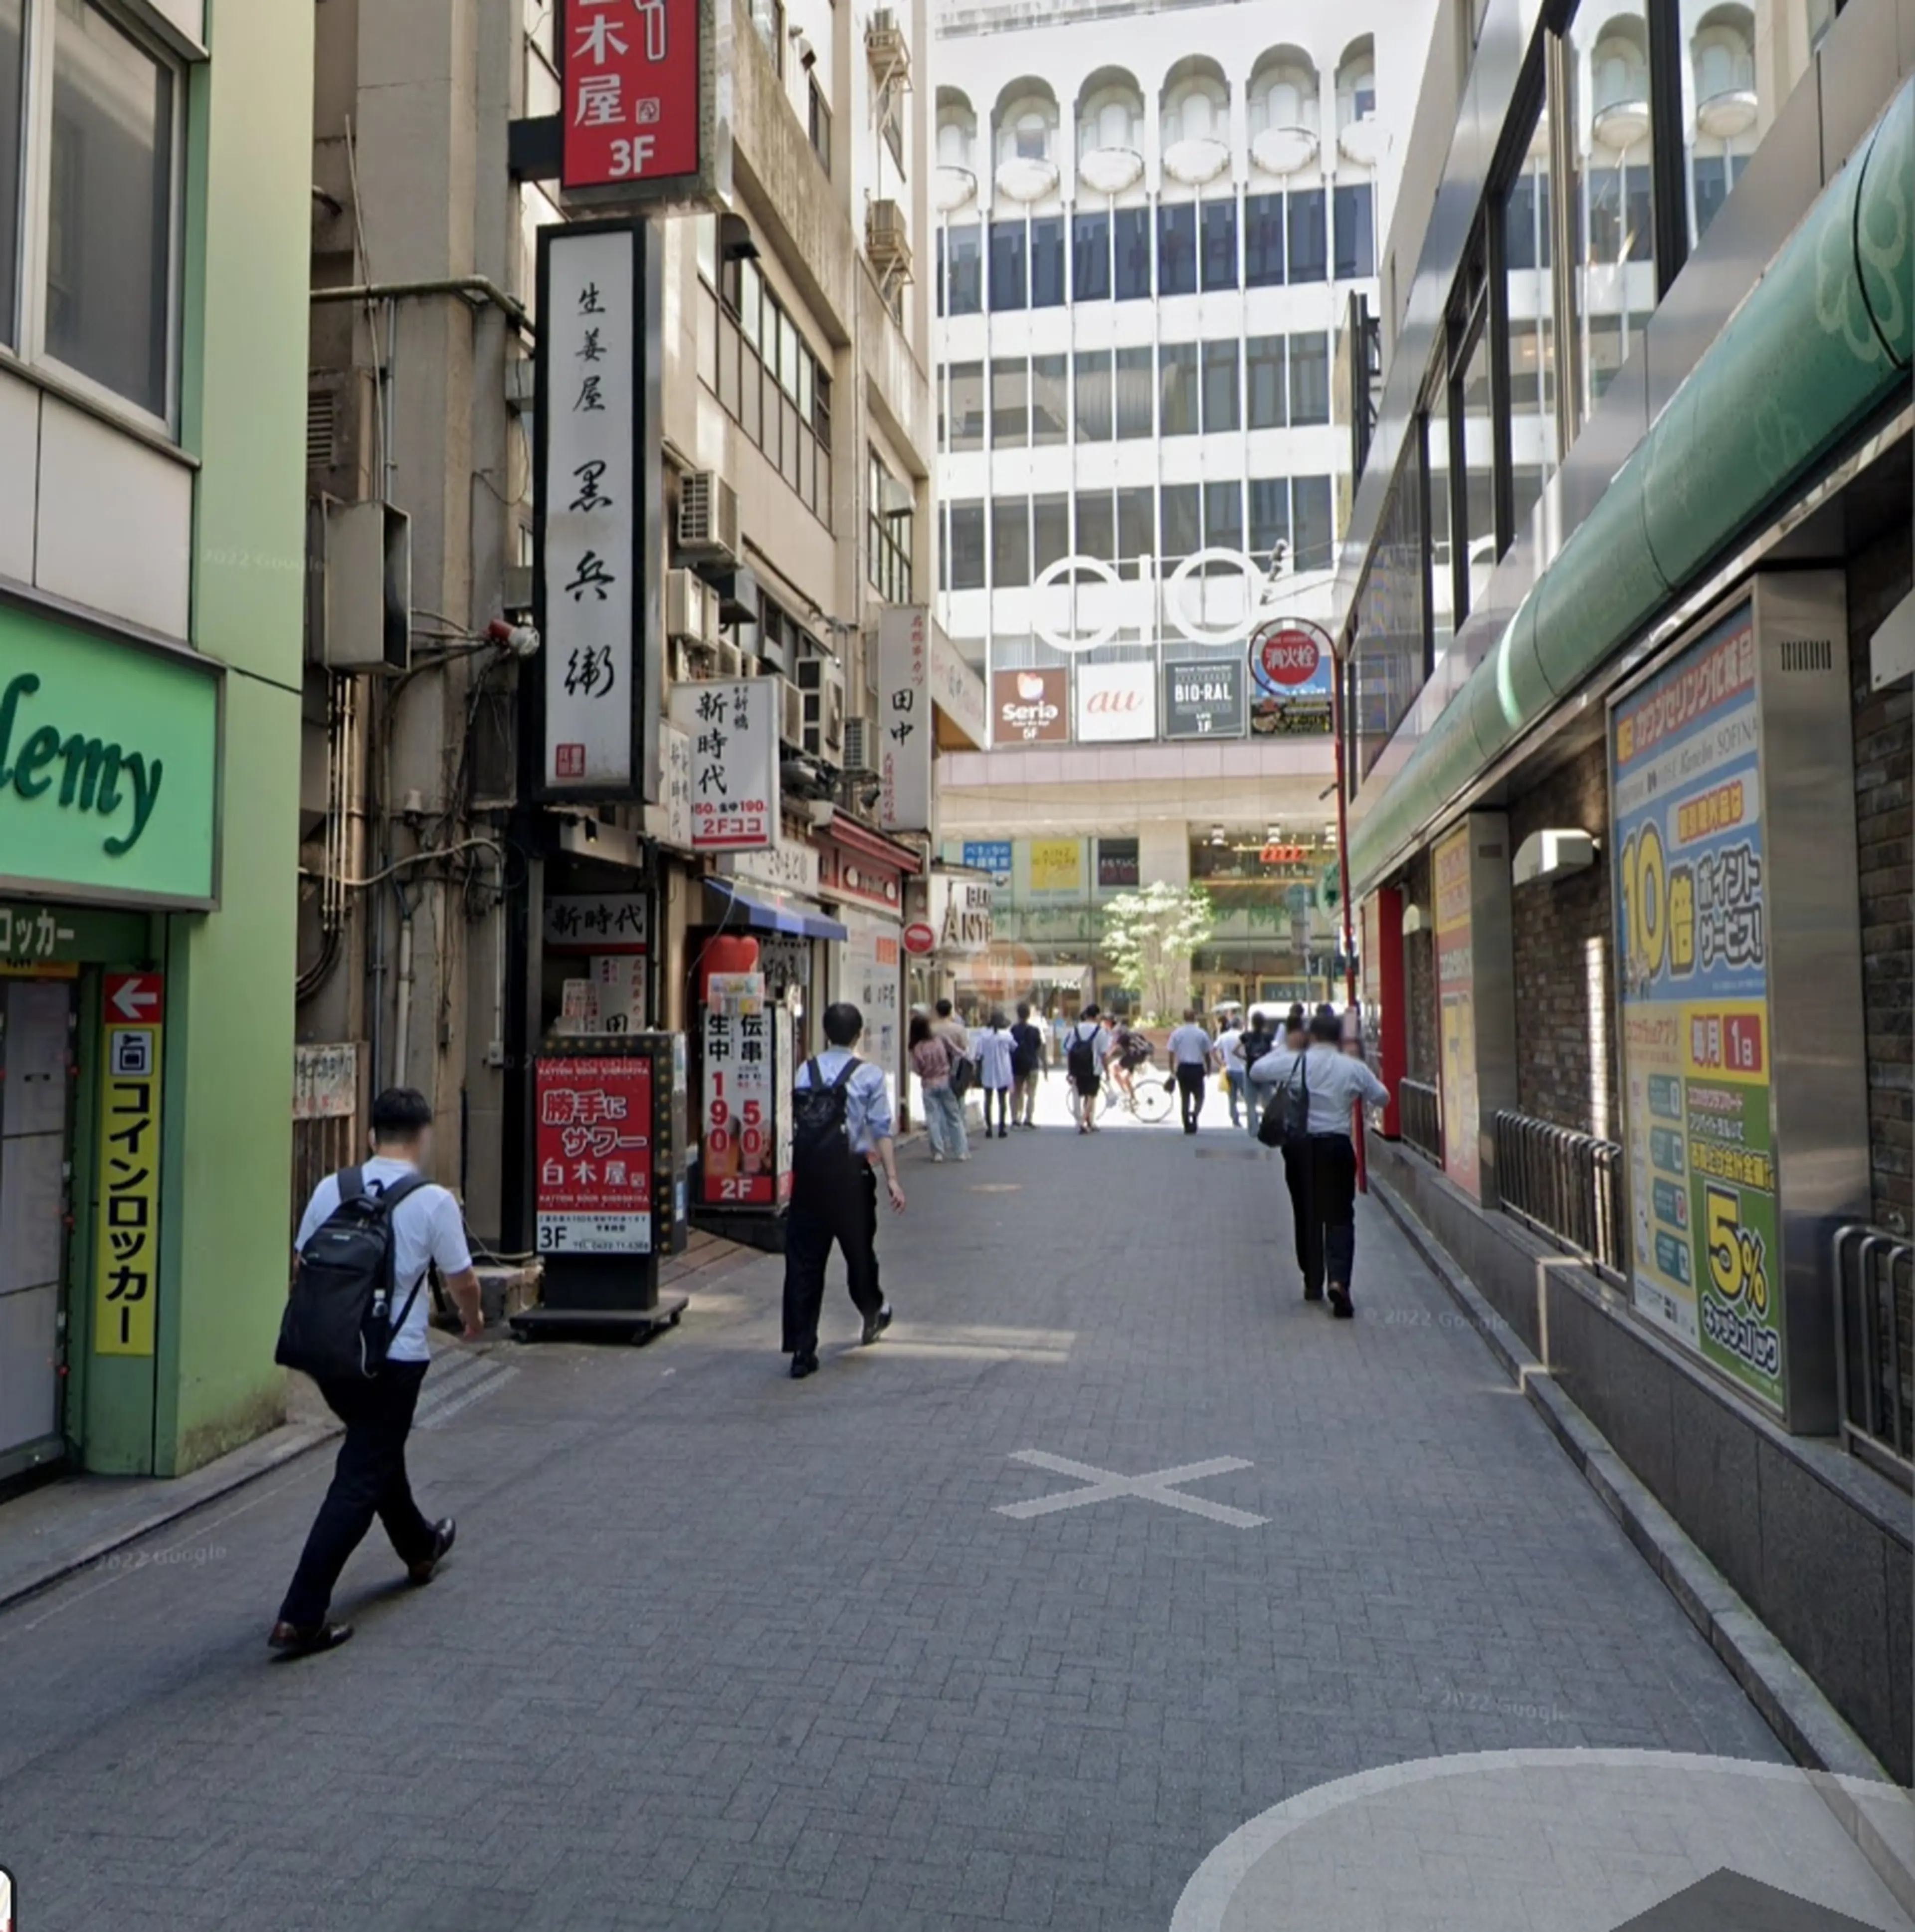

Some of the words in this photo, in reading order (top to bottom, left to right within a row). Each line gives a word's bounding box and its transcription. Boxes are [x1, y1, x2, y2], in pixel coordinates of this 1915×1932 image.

[572, 0, 629, 128] 木屋
[608, 134, 656, 177] 3F
[573, 282, 607, 412] 生姜屋
[1265, 644, 1315, 670] 消火栓
[890, 688, 915, 747] 田中
[1002, 699, 1059, 721] Seria
[1086, 688, 1144, 715] au
[695, 690, 728, 795] 新時代
[704, 818, 762, 834] 2Fココ
[1622, 824, 1695, 977] 10倍
[1698, 844, 1761, 912] ポイント
[551, 903, 643, 937] 新時代
[1700, 903, 1764, 967] サービス!
[708, 1013, 730, 1063] 生中
[741, 1013, 763, 1063] 伝串
[1730, 1020, 1754, 1066] 1日
[542, 1089, 627, 1125] 勝手に
[710, 1071, 728, 1153] 190
[742, 1100, 761, 1154] 50
[562, 1127, 648, 1158] サワー
[542, 1158, 627, 1185] 白木屋
[721, 1178, 754, 1200] 2F
[105, 1082, 151, 1344] コインロッカー
[540, 1225, 568, 1249] 3F
[1707, 1184, 1767, 1317] 5%
[1704, 1297, 1778, 1374] キャッシュバック
